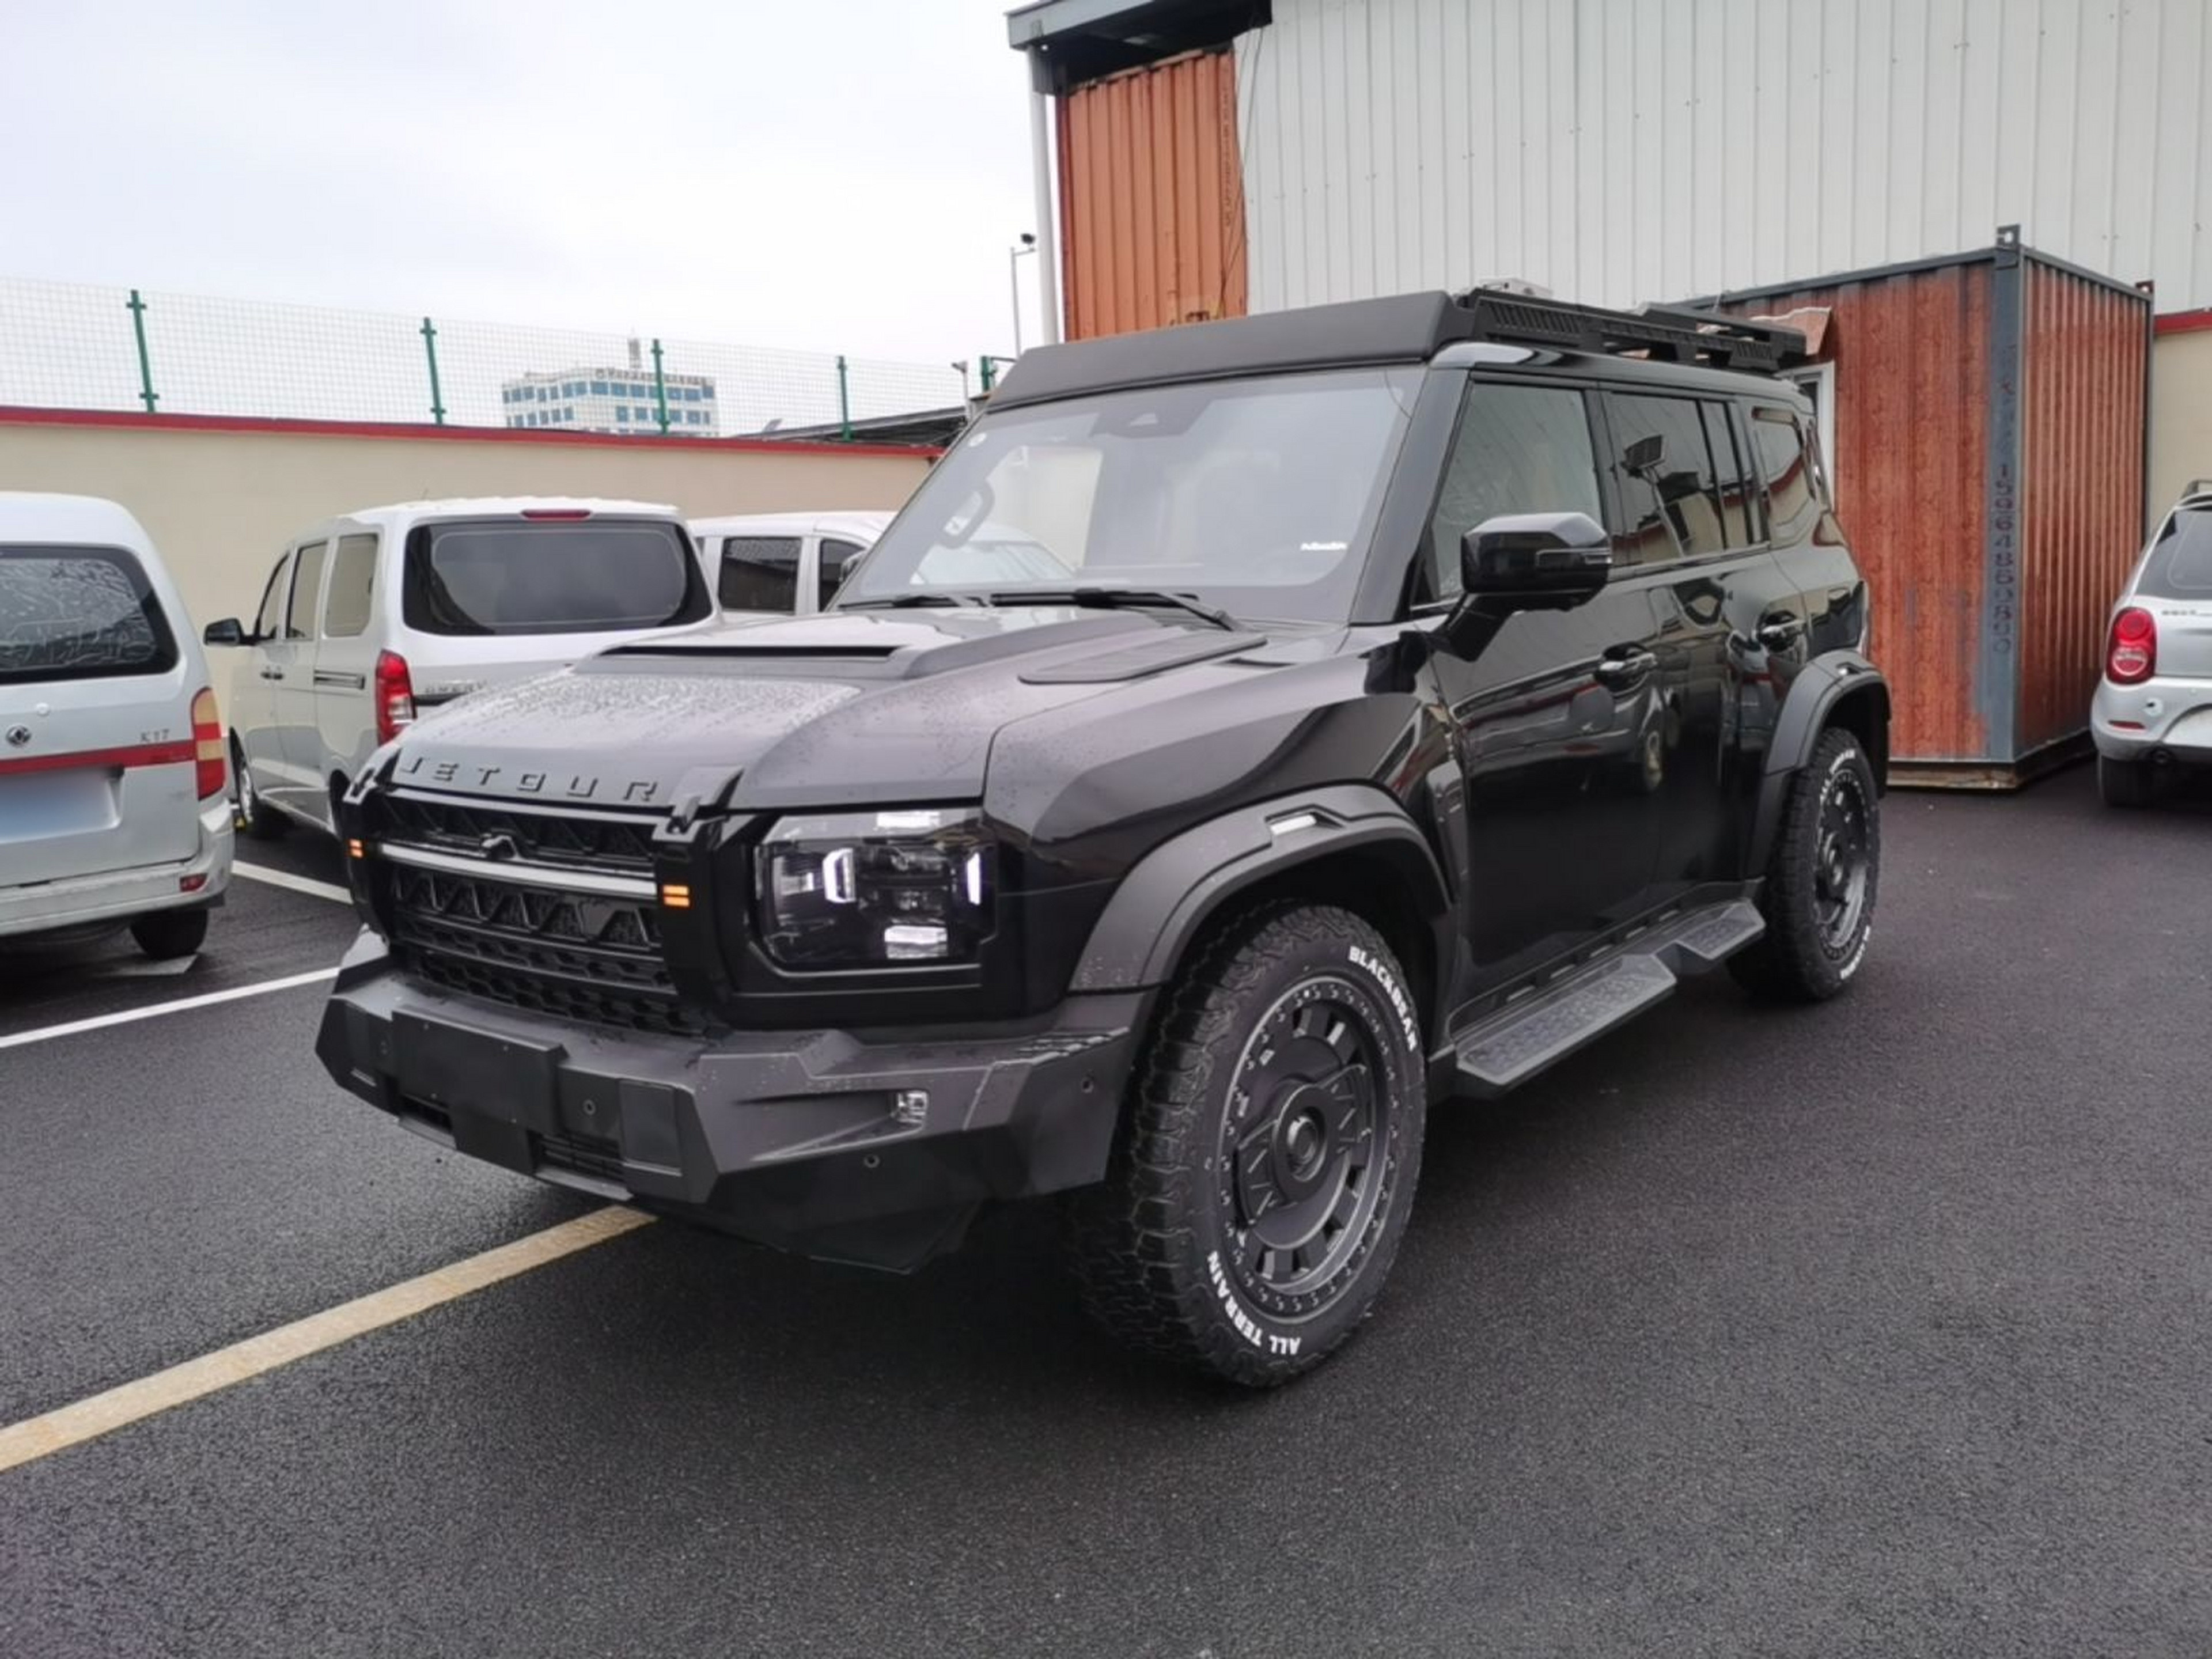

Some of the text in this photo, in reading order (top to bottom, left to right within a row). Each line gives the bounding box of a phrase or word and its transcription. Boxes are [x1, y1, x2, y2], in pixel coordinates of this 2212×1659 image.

[140, 729, 170, 742] K17
[400, 757, 657, 801] JETOUR
[1207, 1251, 1301, 1354] ALL TERRAIN
